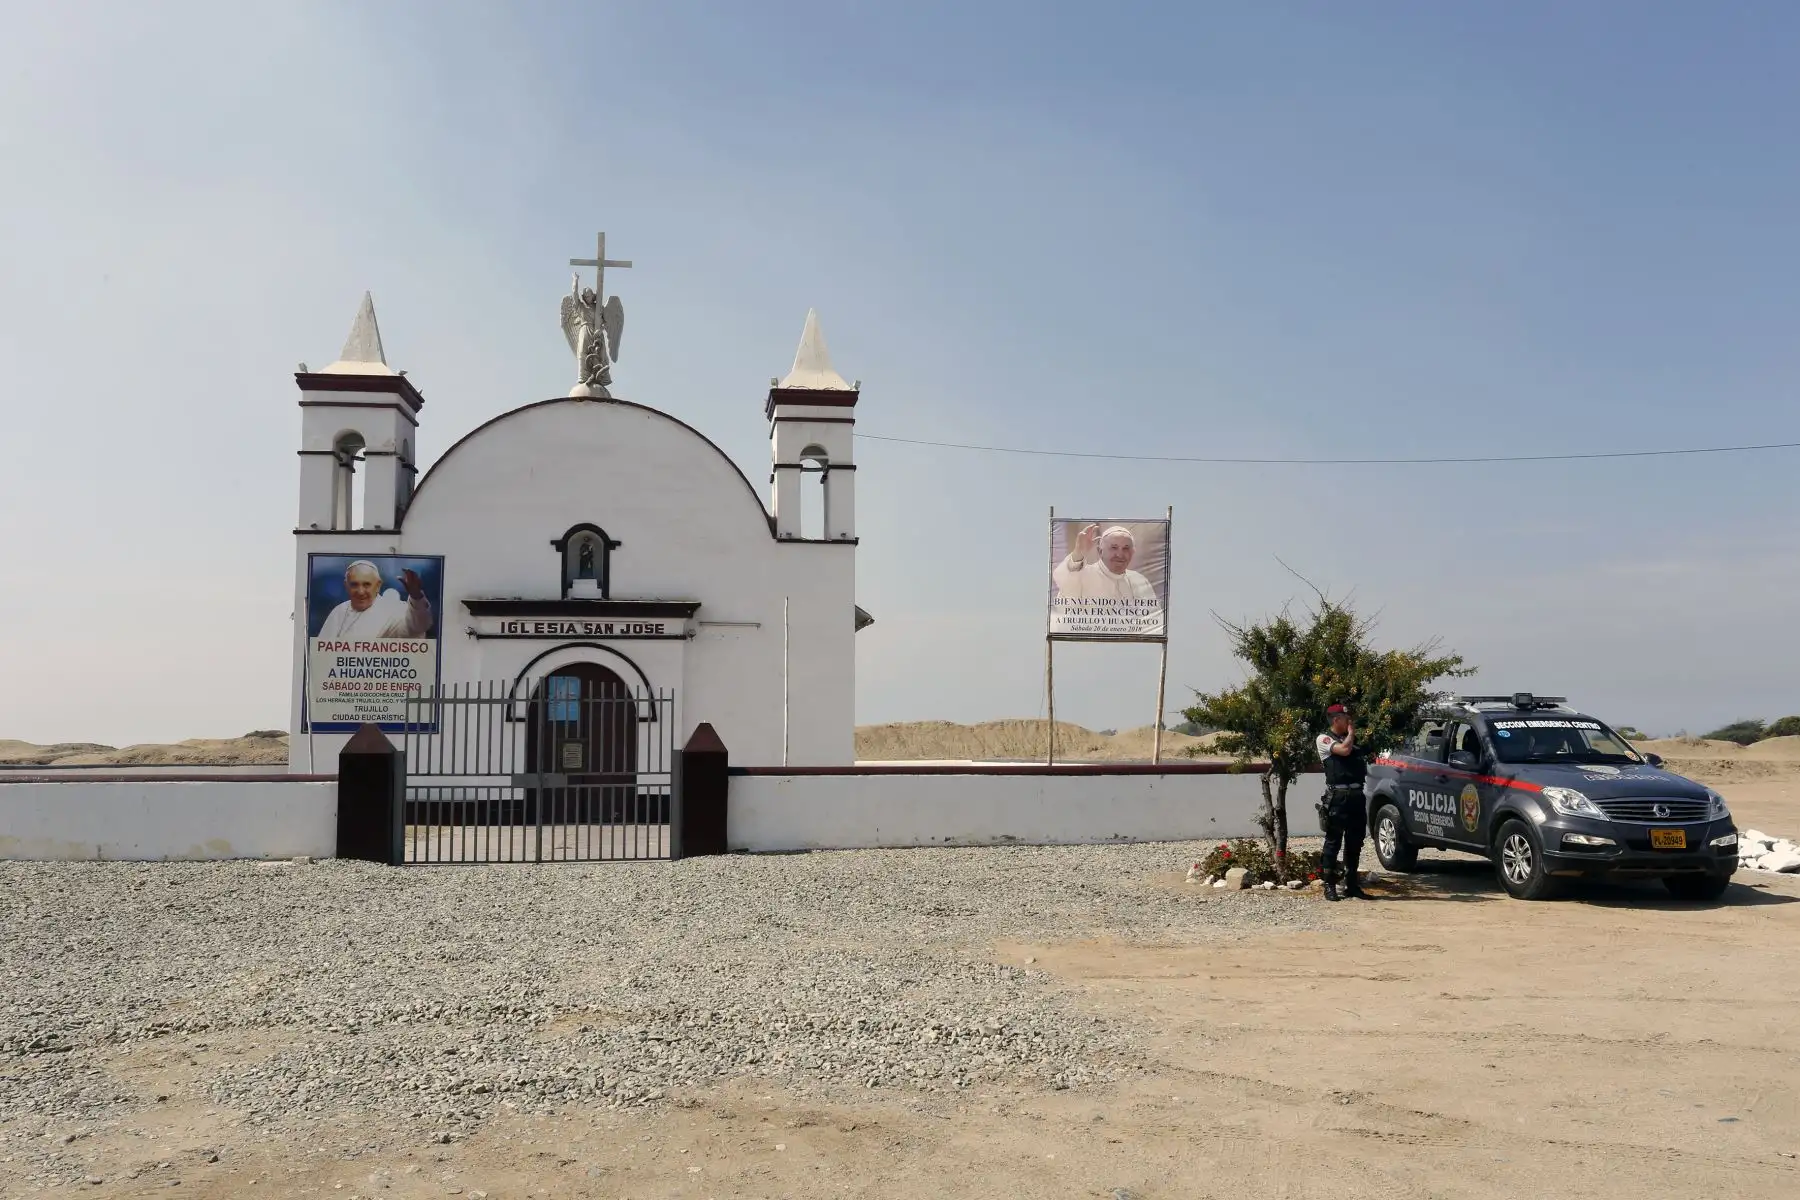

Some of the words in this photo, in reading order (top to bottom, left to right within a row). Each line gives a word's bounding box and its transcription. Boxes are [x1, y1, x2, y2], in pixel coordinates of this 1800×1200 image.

[1054, 597, 1117, 606] BIENVENIDO
[1120, 599, 1132, 607] AL
[1065, 607, 1088, 615] PAPA
[1091, 608, 1149, 617] FRANCISCO
[1108, 618, 1159, 626] HUANCHACO
[500, 621, 578, 634] IGLESIA
[583, 623, 614, 635] SAN
[620, 623, 665, 635] JOSE
[317, 641, 350, 652] PAPA
[354, 642, 429, 654] FRANCISCO
[336, 657, 410, 668] BIENVENIDO
[328, 668, 337, 678] A
[340, 669, 417, 679] HUANCHACO
[363, 682, 373, 691] 20
[375, 683, 388, 691] DE
[390, 683, 421, 692] ENERO
[354, 705, 389, 713] TRUJILLO
[1493, 721, 1528, 730] SECCION
[1525, 720, 1573, 729] EMERGENCIA
[1571, 721, 1601, 730] CENTRO
[1408, 789, 1457, 815] POLICIA
[1429, 813, 1455, 828] EMERGENCIA
[1426, 823, 1444, 837] CENTRO
